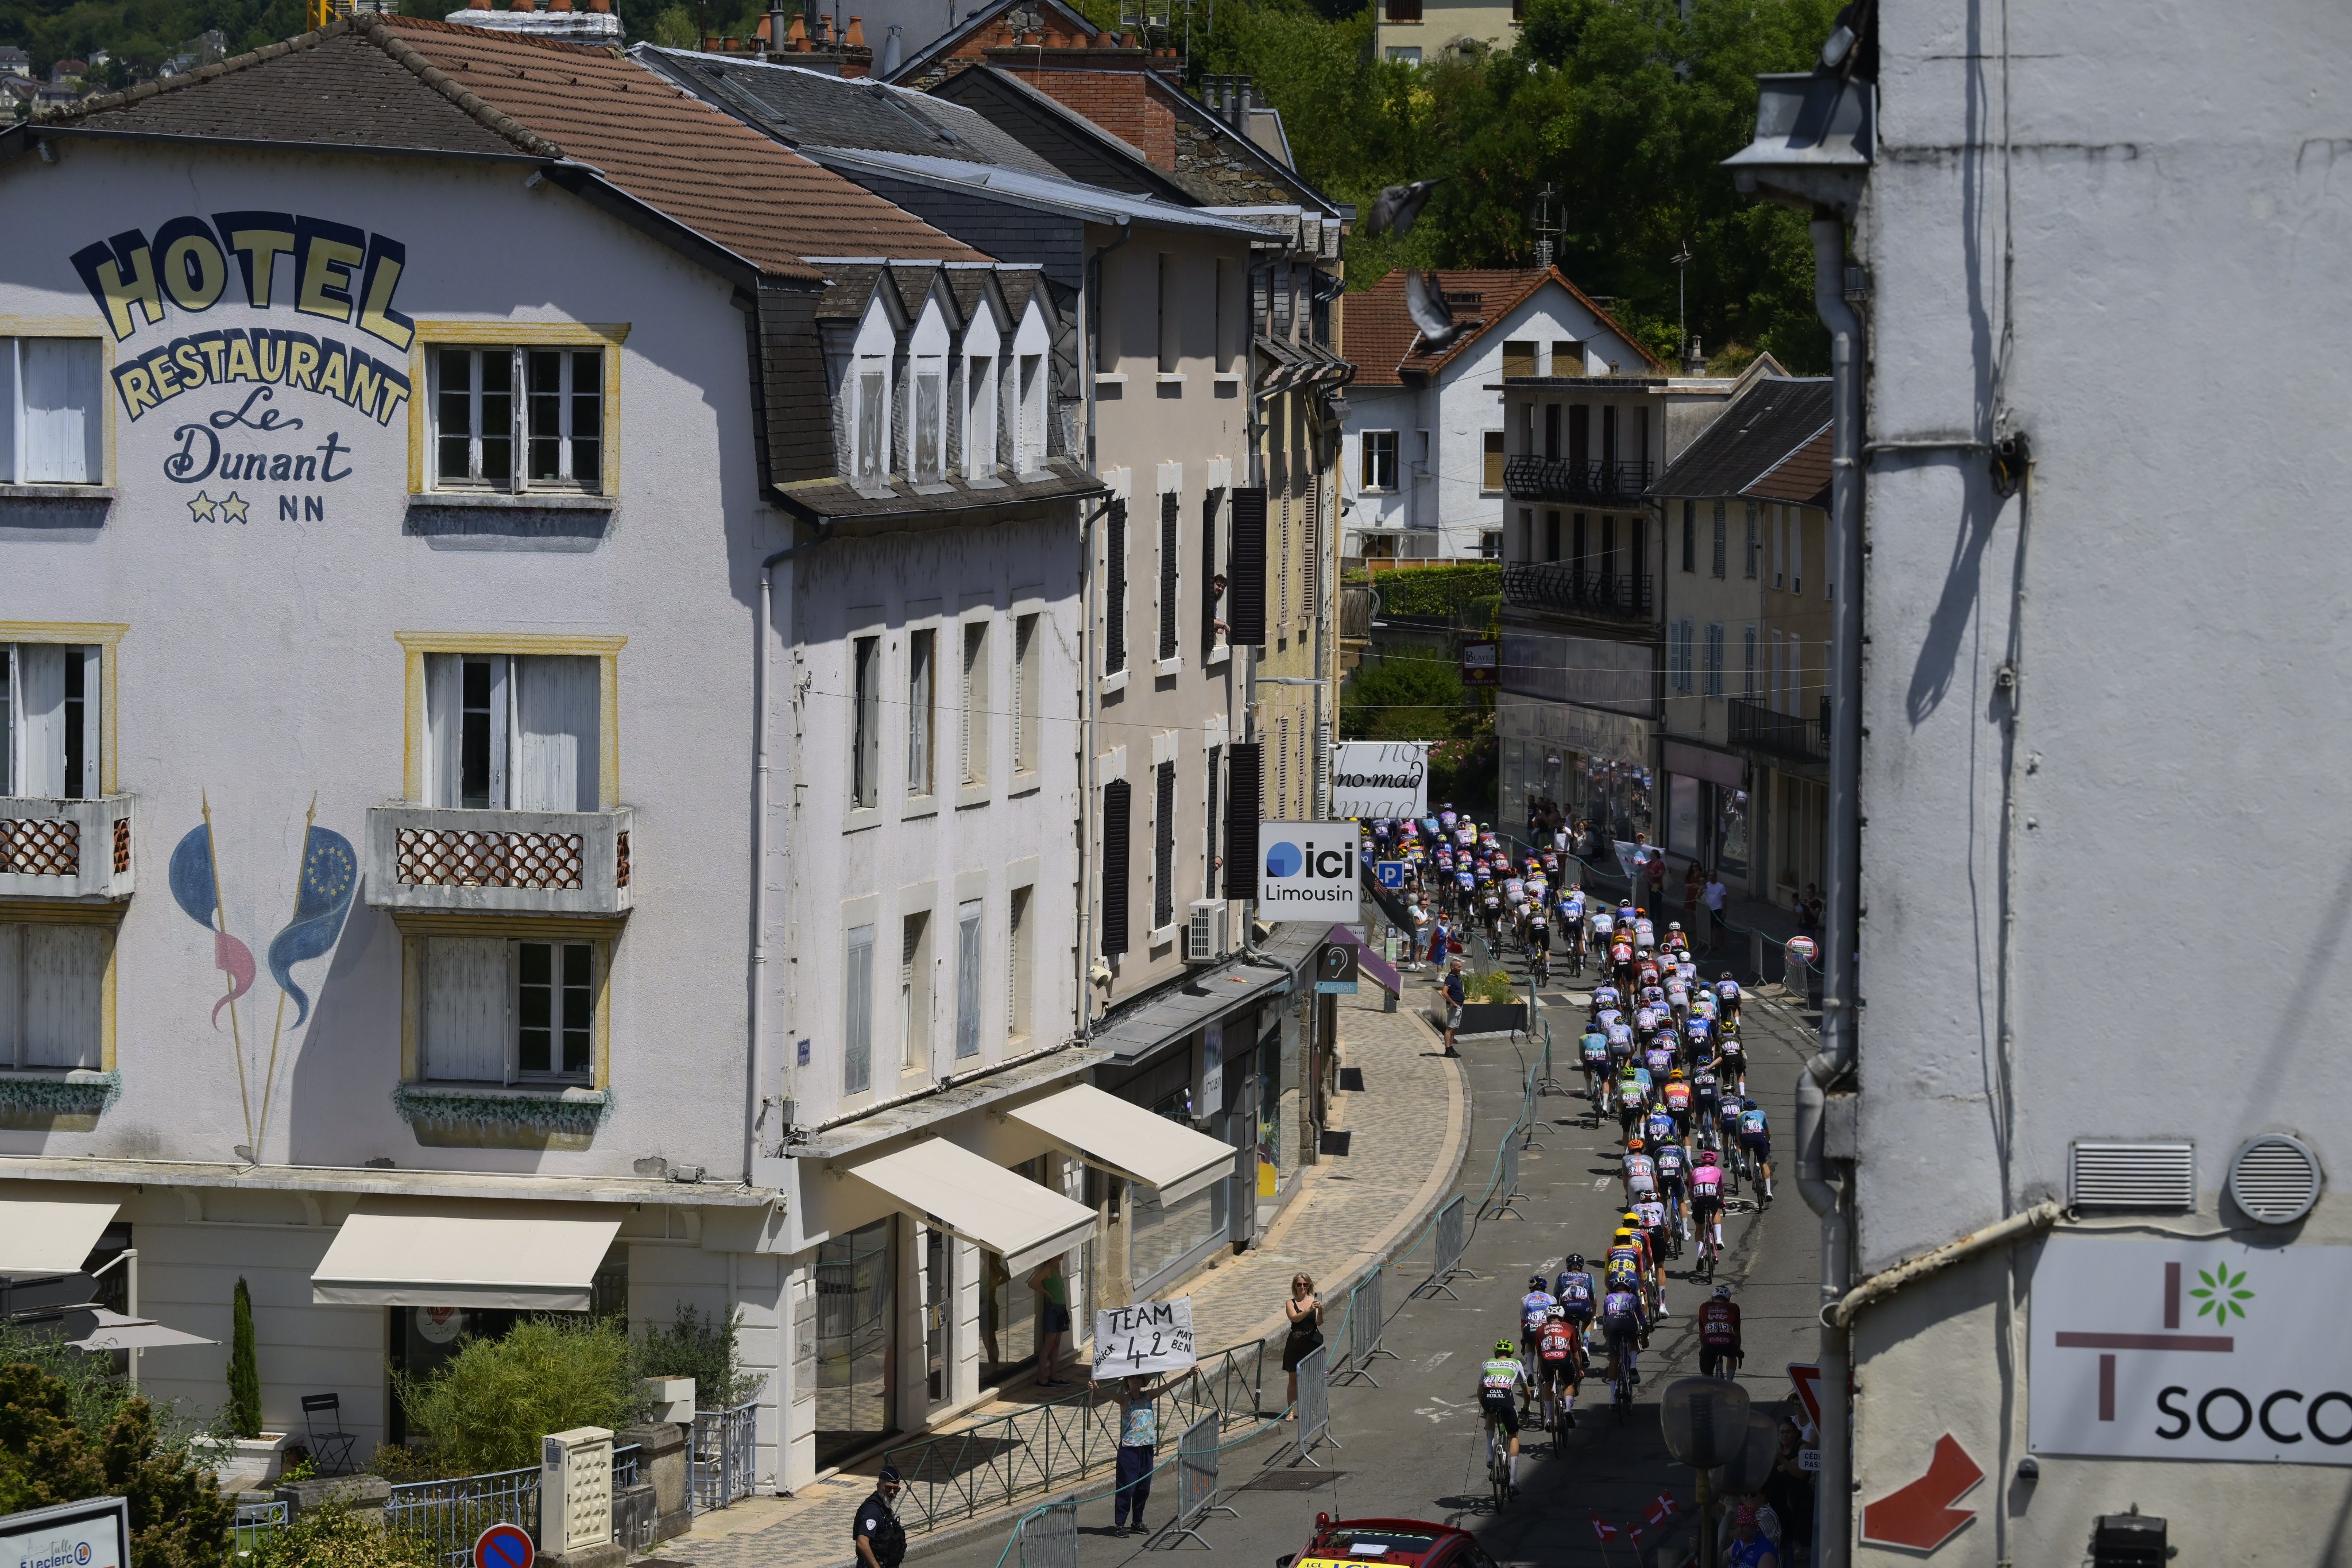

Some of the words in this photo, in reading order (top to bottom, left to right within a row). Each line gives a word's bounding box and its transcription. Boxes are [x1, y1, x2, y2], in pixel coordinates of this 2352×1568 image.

[69, 211, 415, 353] HOTEL
[110, 327, 411, 427] RESTAURANT
[210, 386, 303, 431] Le
[164, 423, 352, 483] Dunant
[279, 495, 323, 521] NN
[1306, 842, 1353, 878] ici
[1385, 868, 1396, 883] P
[1266, 884, 1353, 901] Limousin
[1321, 984, 1354, 993] Audilab
[1204, 1071, 1221, 1095] Limousin
[1610, 1261, 1618, 1269] 32
[1626, 1260, 1634, 1269] 32
[1579, 1287, 1586, 1296] 73
[1530, 1312, 1538, 1320] 26
[1608, 1302, 1618, 1311] 117
[1109, 1304, 1173, 1334] TEAM
[1177, 1329, 1193, 1341] MAT
[1127, 1331, 1168, 1369] 42
[1171, 1339, 1191, 1353] BEN
[2155, 1385, 2352, 1446] SOCO
[49, 1539, 74, 1555] Tulle
